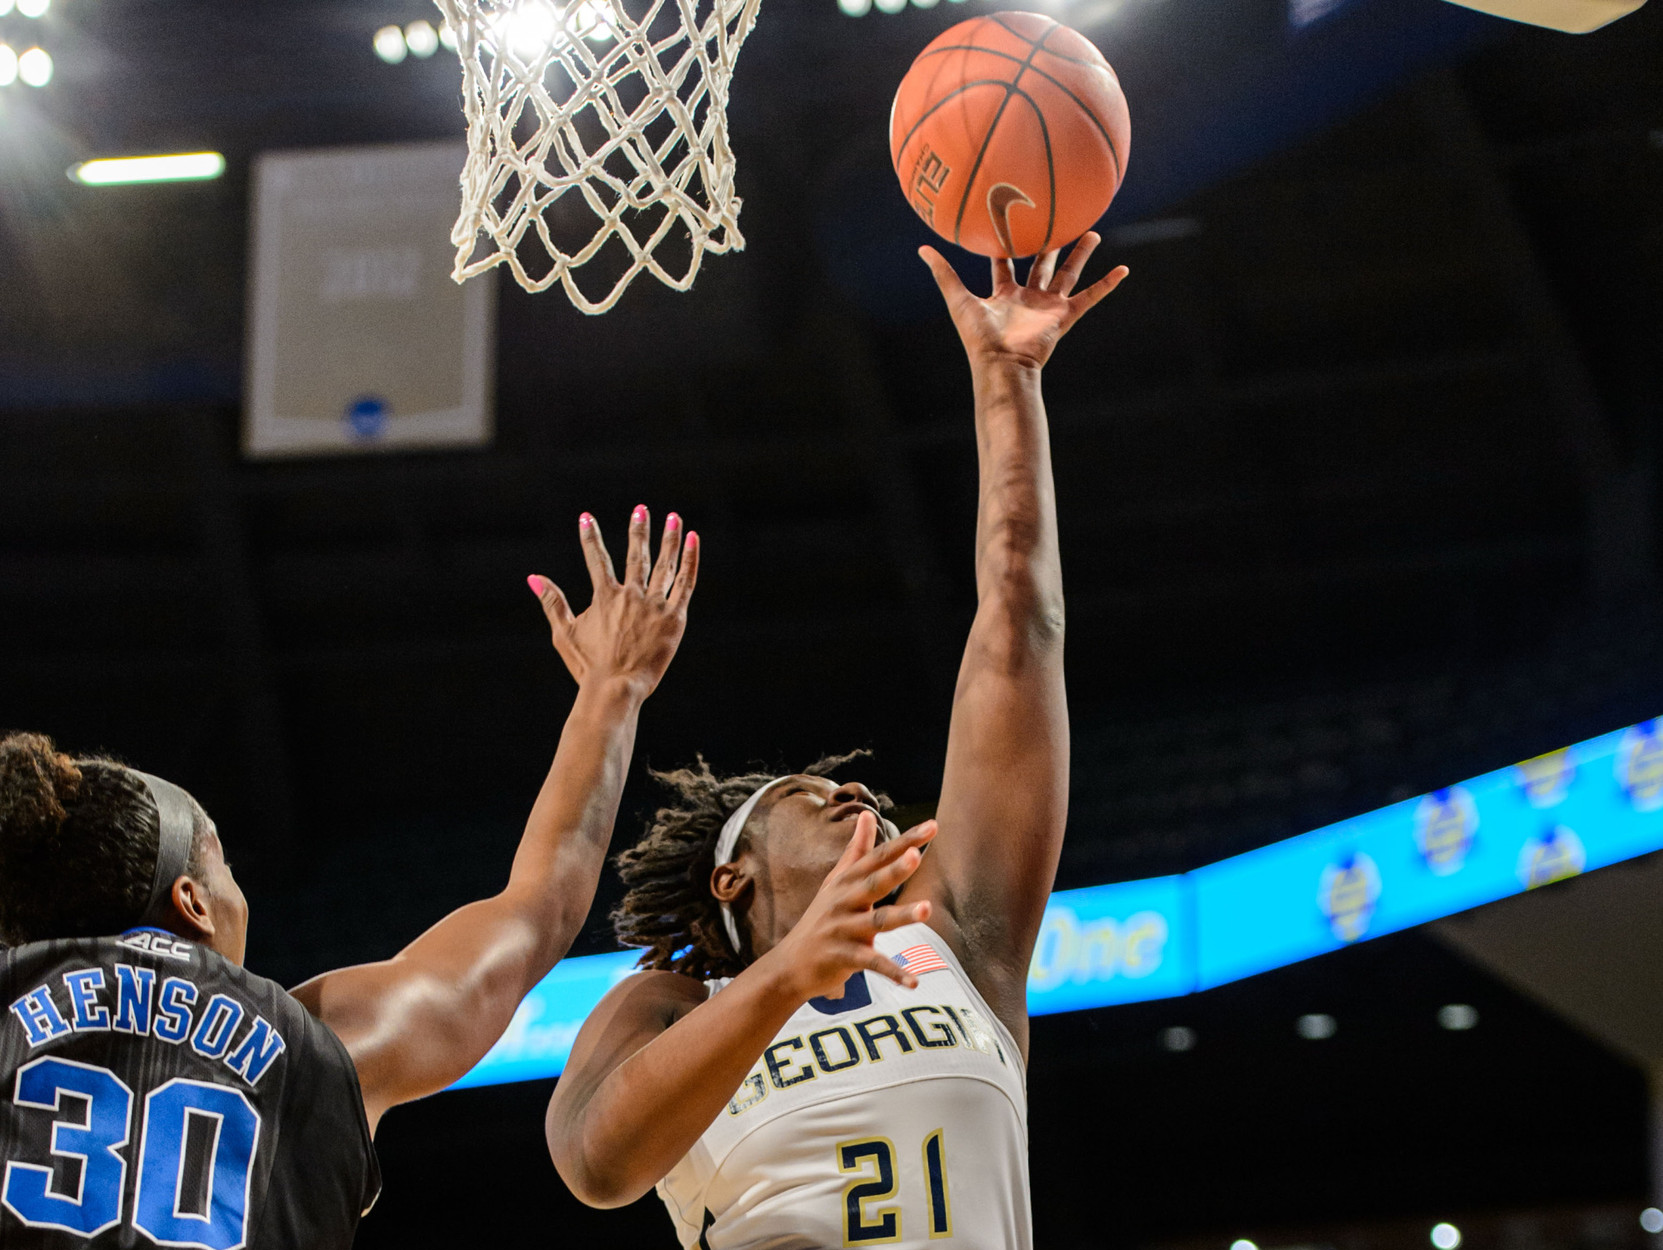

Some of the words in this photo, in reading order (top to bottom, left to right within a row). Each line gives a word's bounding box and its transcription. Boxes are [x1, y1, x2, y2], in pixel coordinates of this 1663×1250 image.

[122, 932, 193, 958] ACC
[9, 963, 286, 1086] HENSON
[835, 1127, 953, 1249] 21
